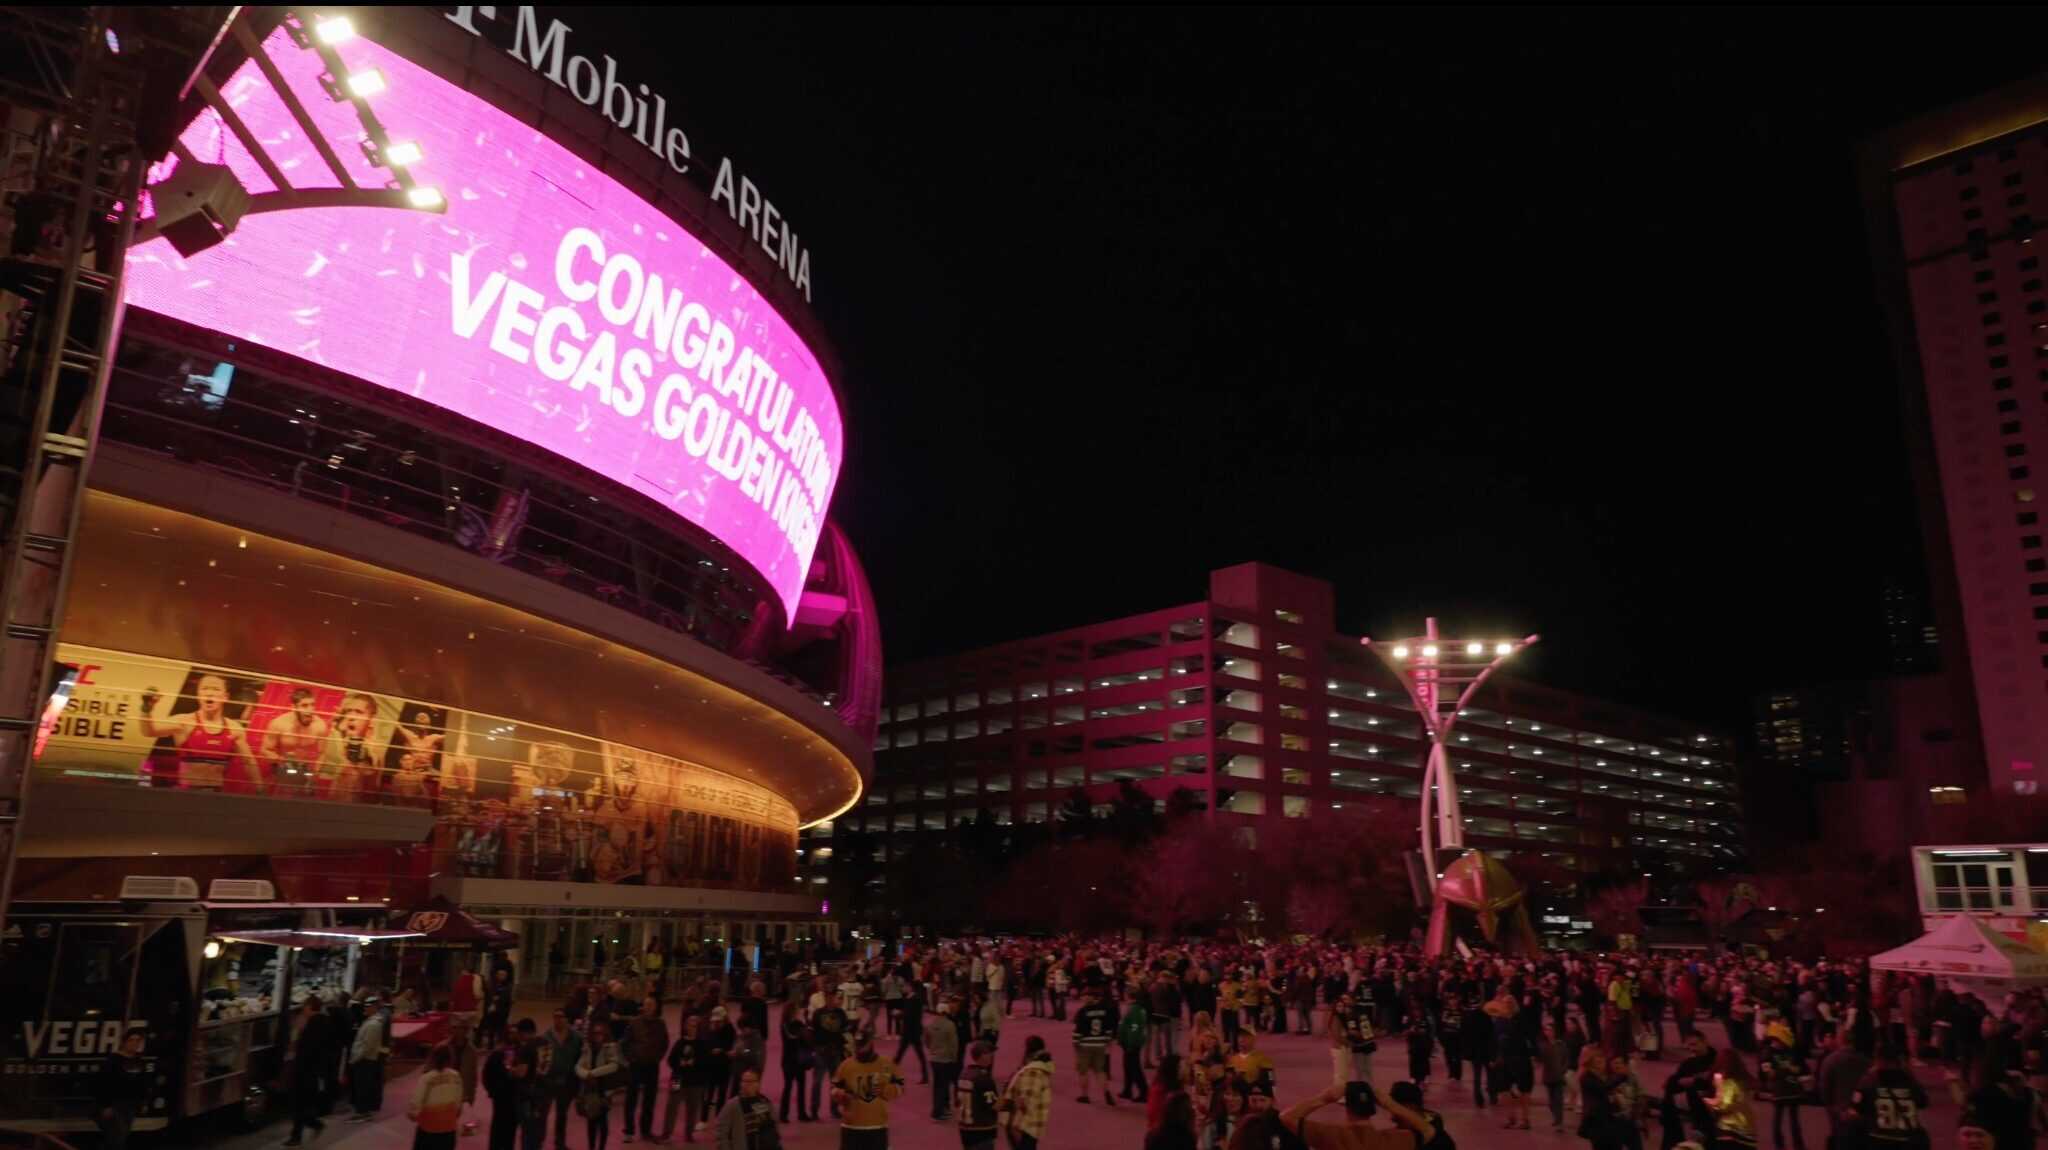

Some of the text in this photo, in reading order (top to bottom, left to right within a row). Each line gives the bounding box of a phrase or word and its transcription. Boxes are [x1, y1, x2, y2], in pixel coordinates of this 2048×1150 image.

[711, 157, 811, 303] ARENA
[451, 253, 653, 416] VEGAS
[653, 374, 784, 513] GOLDEN
[51, 716, 125, 740] SIBLE
[66, 698, 128, 717] SIBLE
